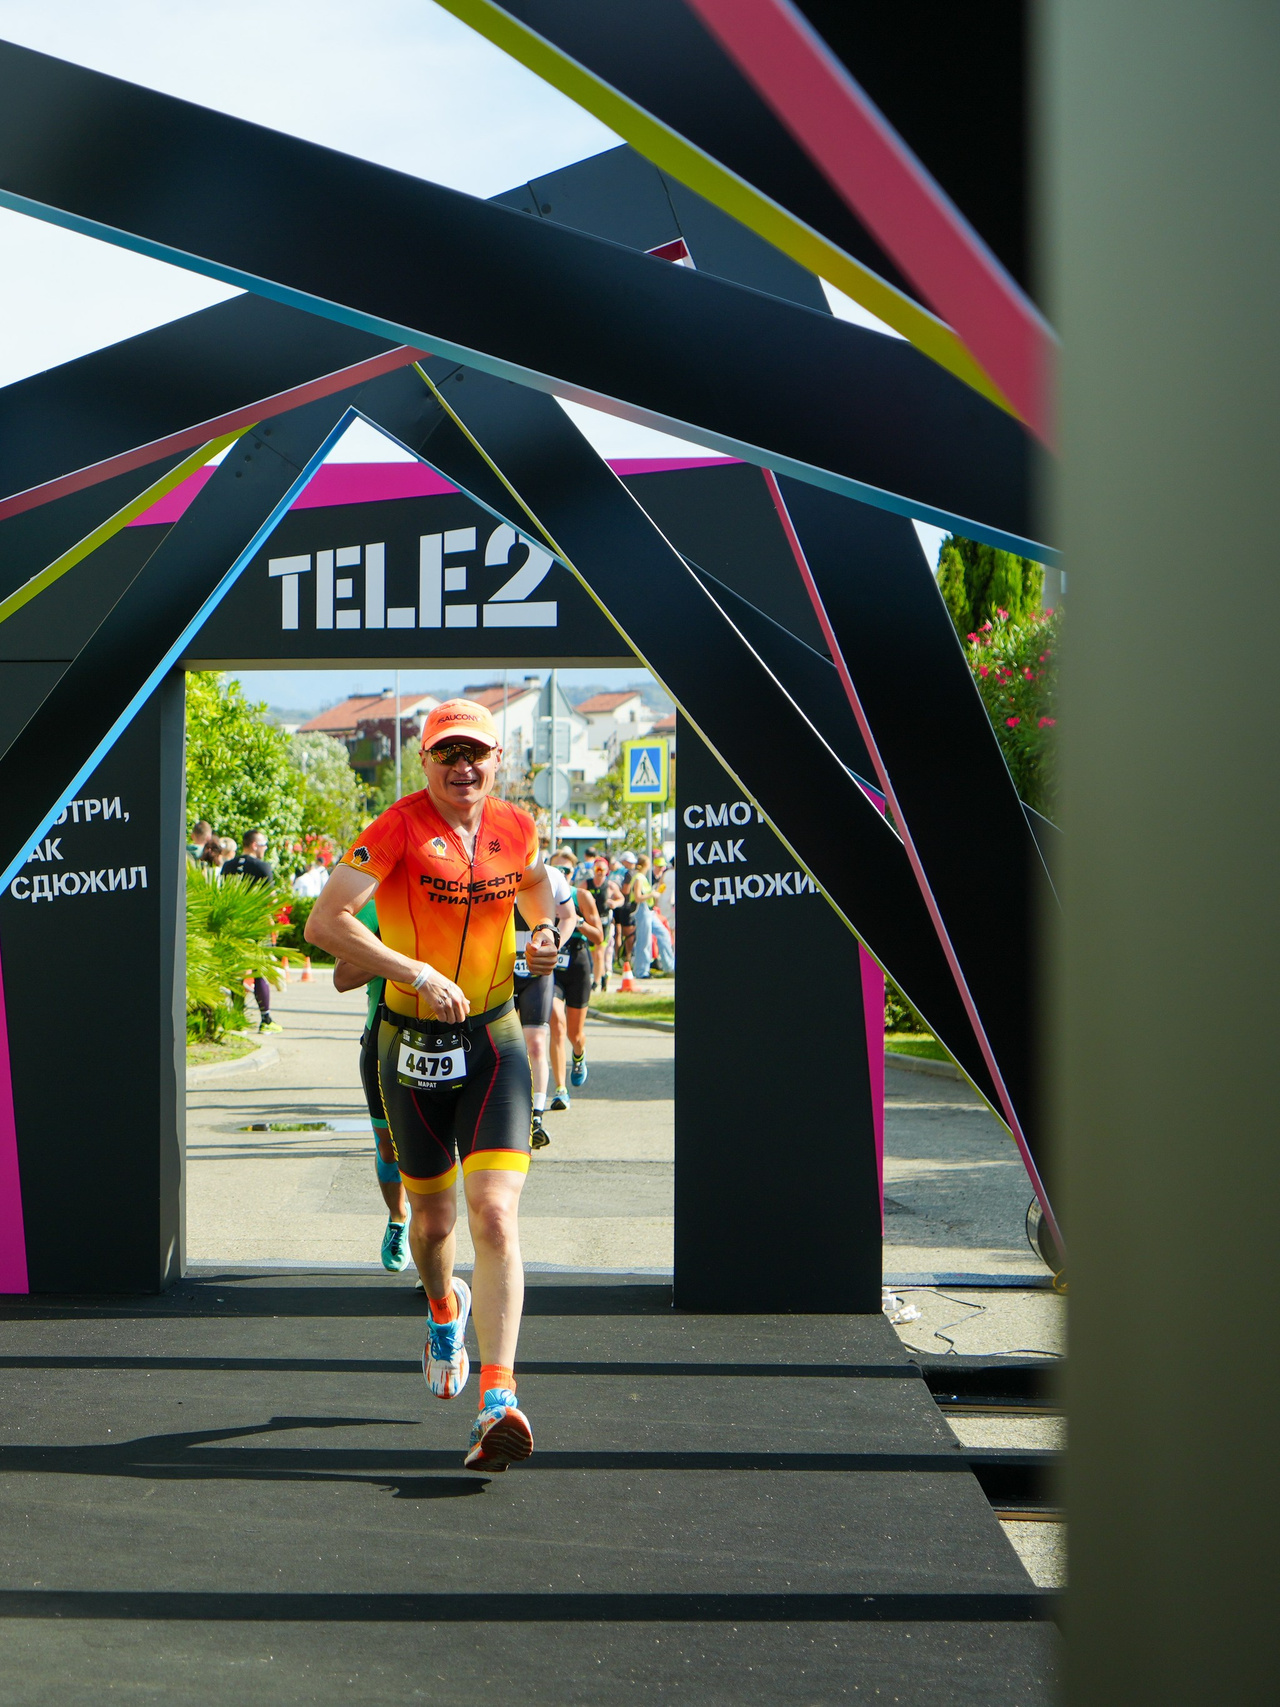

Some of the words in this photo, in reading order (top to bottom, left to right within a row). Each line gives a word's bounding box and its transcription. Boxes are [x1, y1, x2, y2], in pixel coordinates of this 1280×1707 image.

[268, 522, 558, 630] TELE2
[26, 838, 64, 863] АК
[686, 838, 747, 866] КАК
[10, 865, 148, 904] СДЮЖИЛ
[419, 871, 523, 893] РОСНЕФТЬ
[689, 871, 822, 907] СДЮЖИ
[427, 887, 516, 905] ТРИАТЛОН
[405, 1053, 454, 1077] 4479
